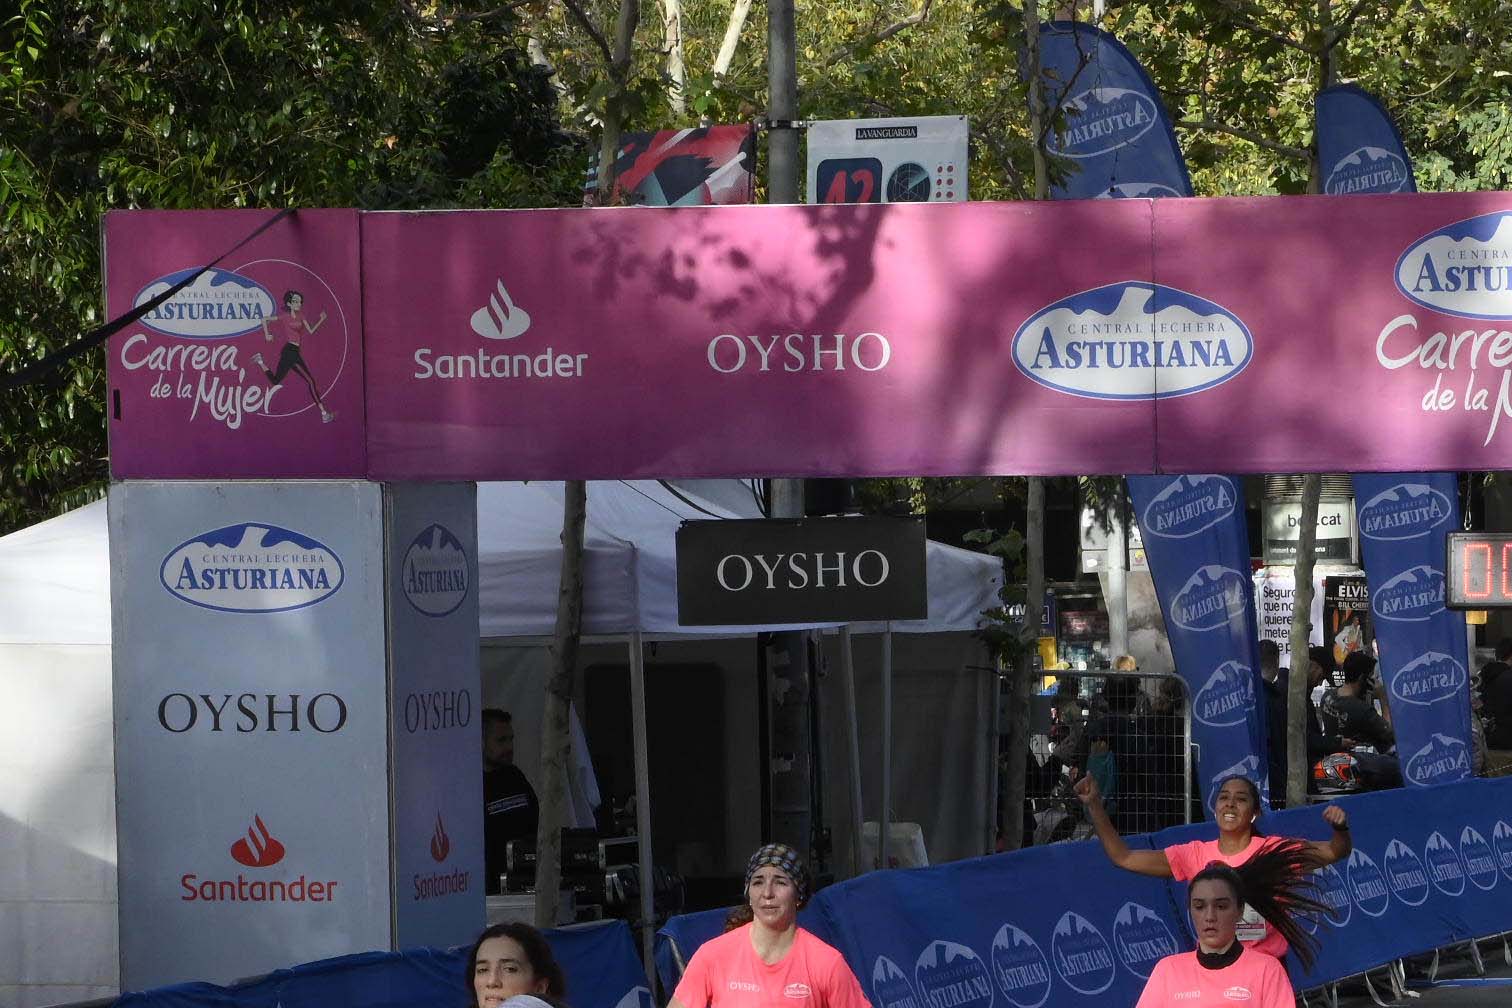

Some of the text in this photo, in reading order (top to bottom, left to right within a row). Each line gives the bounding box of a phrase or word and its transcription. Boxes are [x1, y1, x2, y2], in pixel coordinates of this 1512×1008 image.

[144, 294, 264, 321] ASTURIANA
[1067, 321, 1226, 335] CENTRAL LECHERA
[121, 334, 239, 371] Carrera
[414, 347, 588, 379] Santander
[707, 333, 892, 373] OYSHO
[1030, 326, 1235, 370] ASTURIANA
[150, 371, 283, 430] de la Mujer
[1421, 373, 1456, 411] de
[1464, 373, 1489, 411] la
[174, 556, 332, 592] ASTURIANA
[202, 553, 325, 564] CENTRAL LECHERA
[716, 549, 890, 592] OYSHO
[1263, 602, 1280, 614] que
[1264, 614, 1293, 626] quiere
[157, 692, 348, 734] OYSHO
[404, 688, 472, 734] OYSHO
[181, 874, 338, 902] Santander
